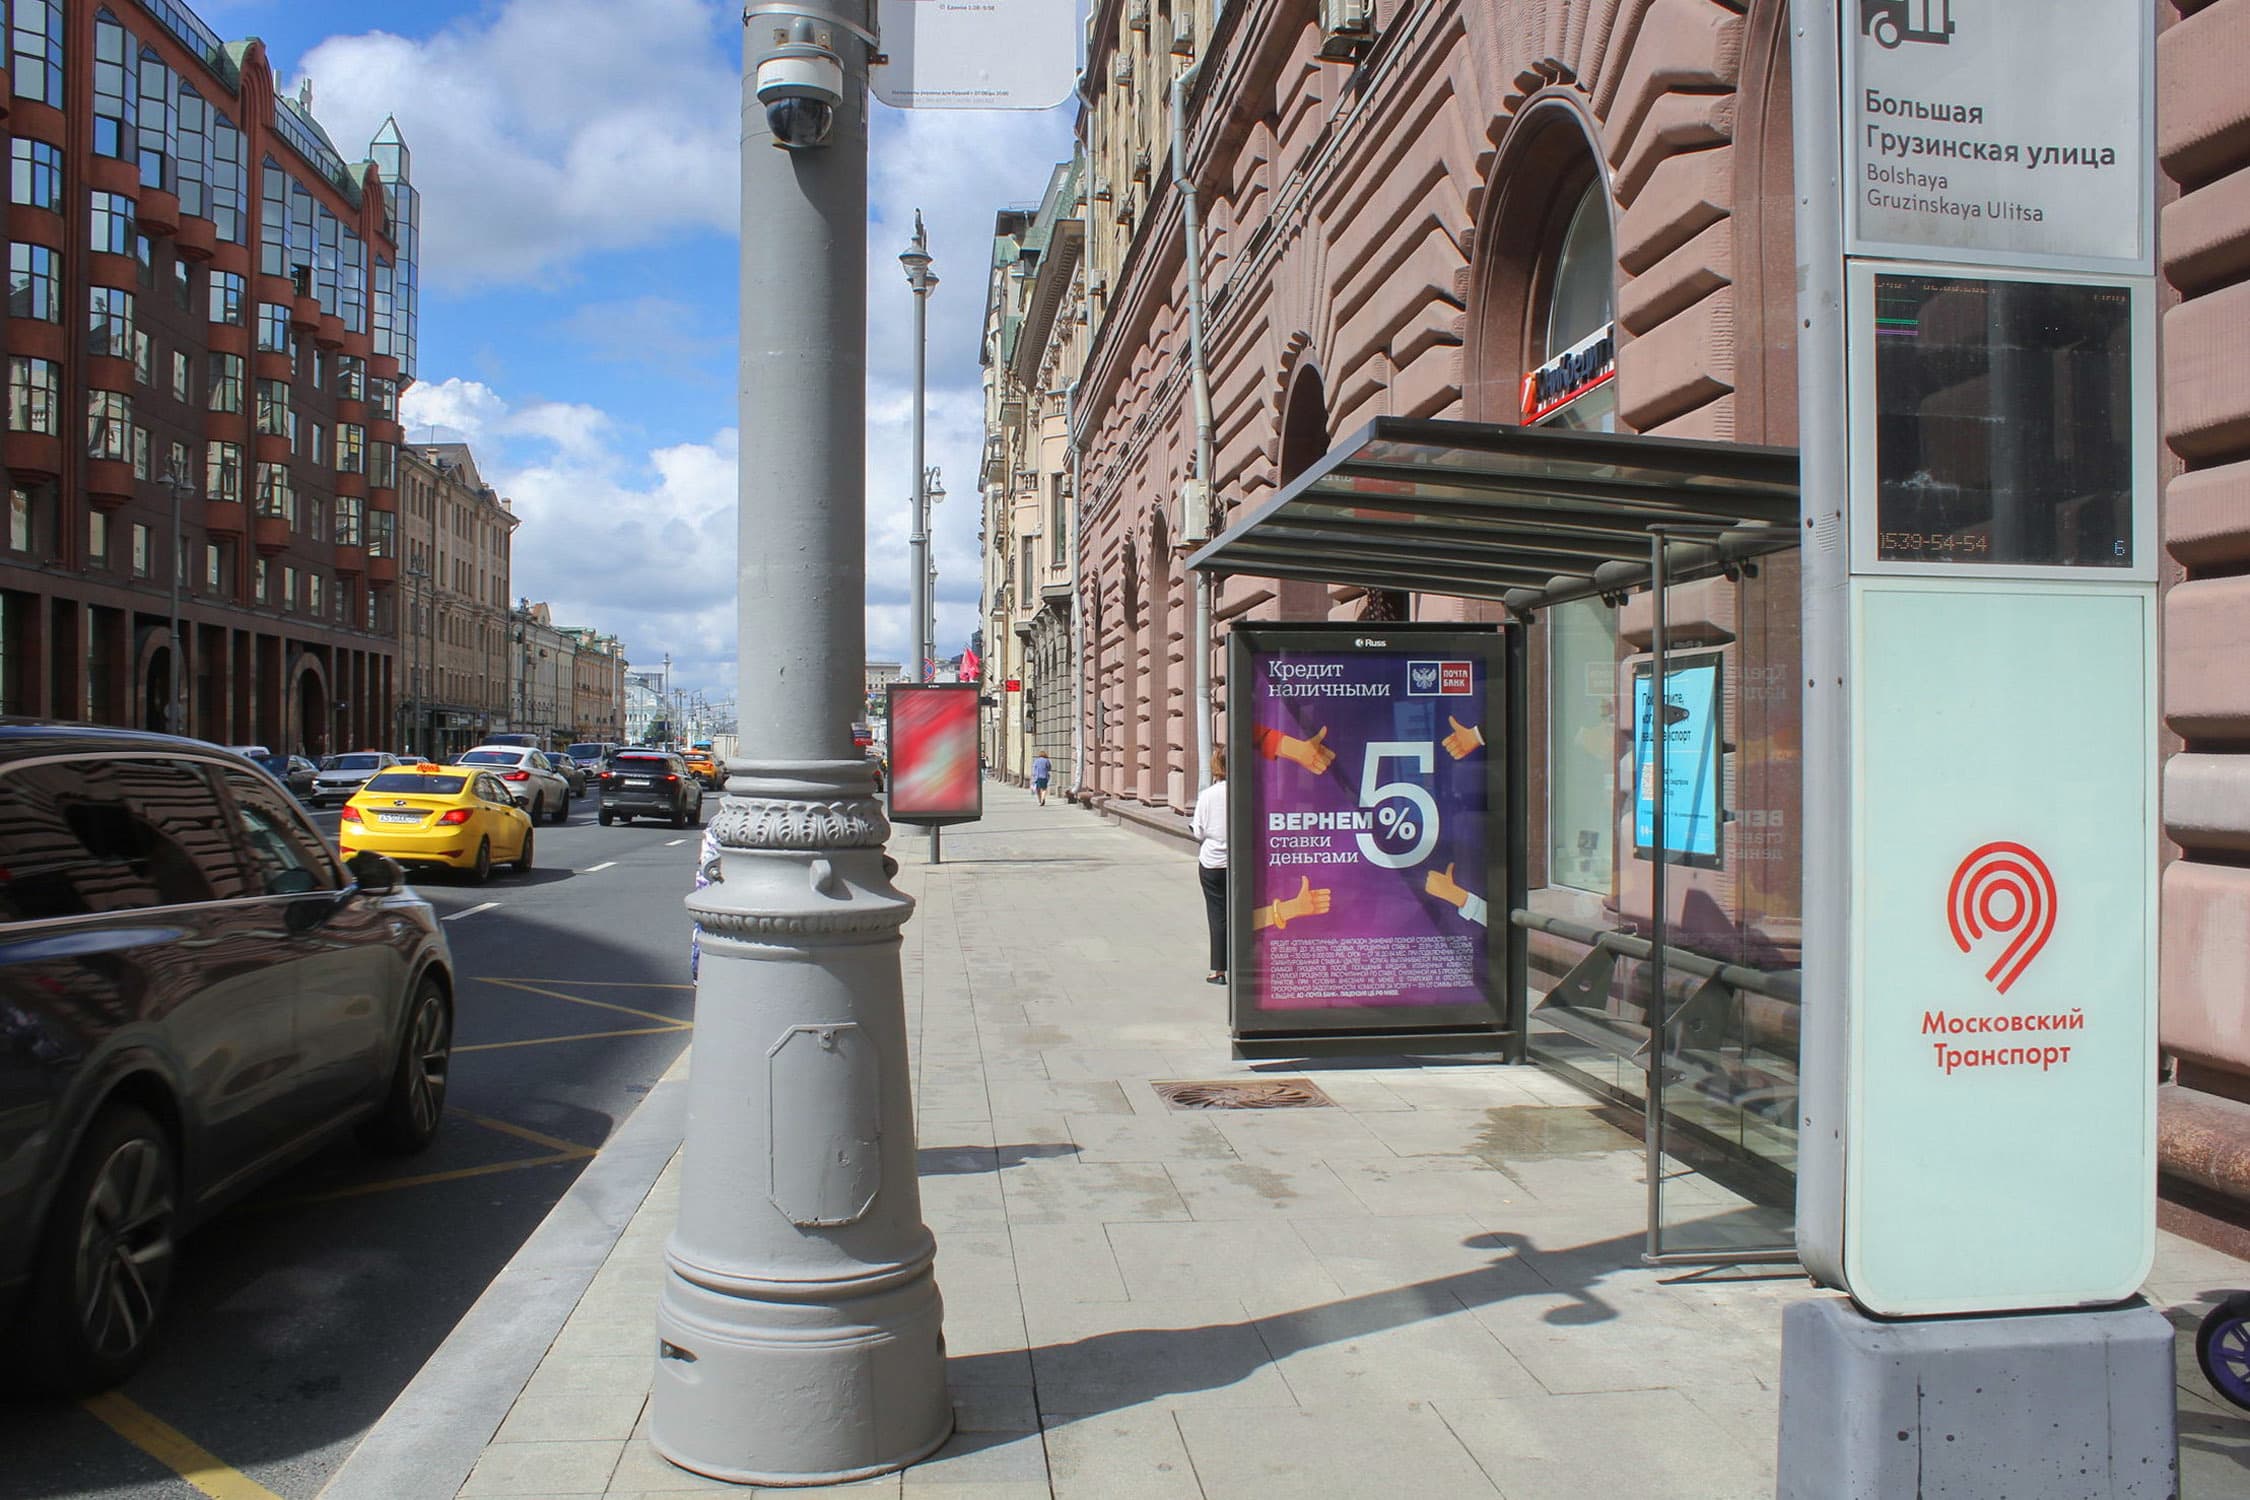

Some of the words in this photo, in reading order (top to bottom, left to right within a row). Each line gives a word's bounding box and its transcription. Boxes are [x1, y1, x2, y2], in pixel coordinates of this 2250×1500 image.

[1865, 89, 1983, 124] Большая
[1867, 124, 2018, 163] Грузинская
[2026, 146, 2115, 169] улица
[1867, 163, 1948, 190] Bolshaya
[1867, 188, 1981, 218] Gruzinskaya
[1987, 201, 2043, 222] Ulitsa
[2113, 540, 2126, 557] 6
[1365, 638, 1387, 648] Russ
[1268, 660, 1344, 681] Кредит
[1443, 670, 1469, 678] ПОЧТА
[1268, 683, 1391, 698] наличными
[1443, 679, 1465, 687] БАНК
[1268, 812, 1374, 831] ВЕРНЕМ
[1269, 837, 1331, 849] ставки
[1269, 850, 1359, 867] деньгами
[1921, 1008, 2084, 1034] Московский
[1933, 1042, 2071, 1075] Транспорт
